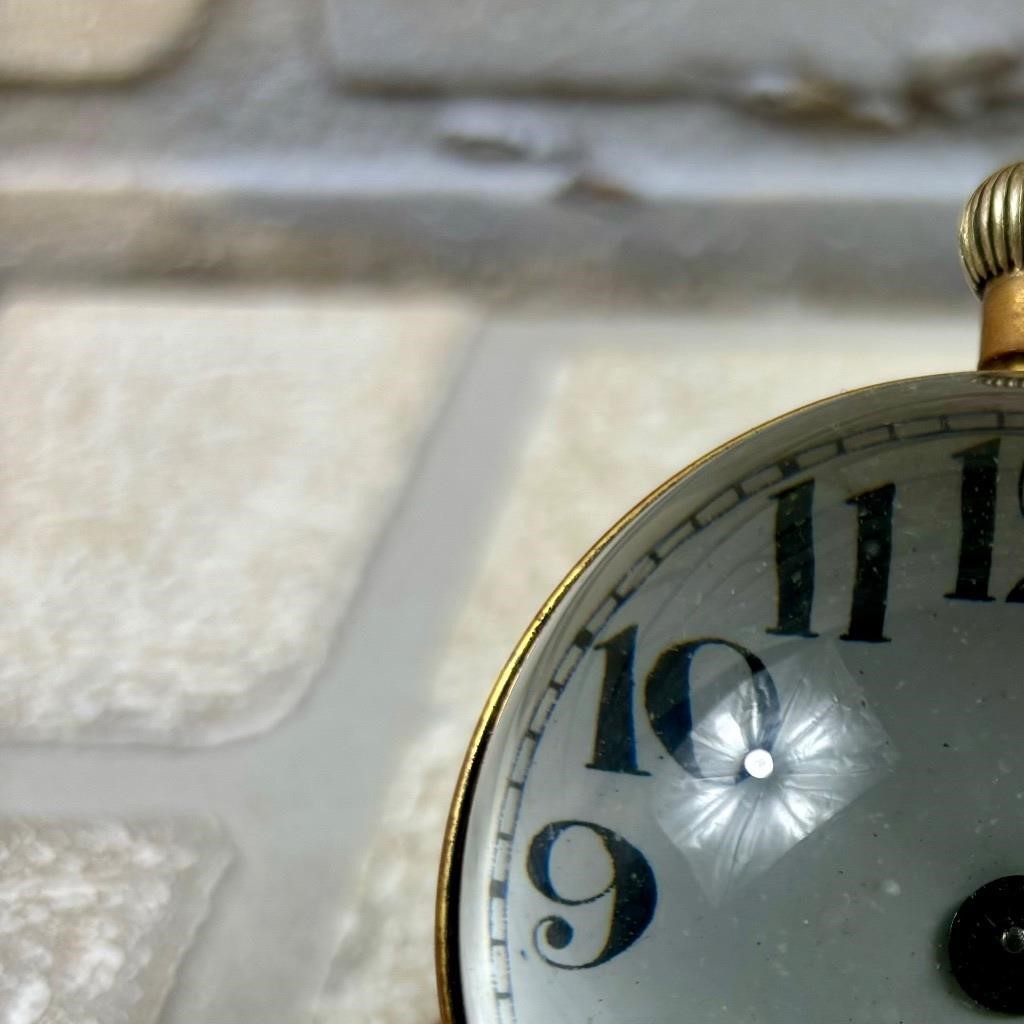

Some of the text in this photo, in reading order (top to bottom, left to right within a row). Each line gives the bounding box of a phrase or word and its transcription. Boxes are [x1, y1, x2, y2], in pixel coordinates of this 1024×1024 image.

[766, 479, 896, 643] 11
[585, 624, 782, 785] 10
[526, 819, 659, 970] 9
